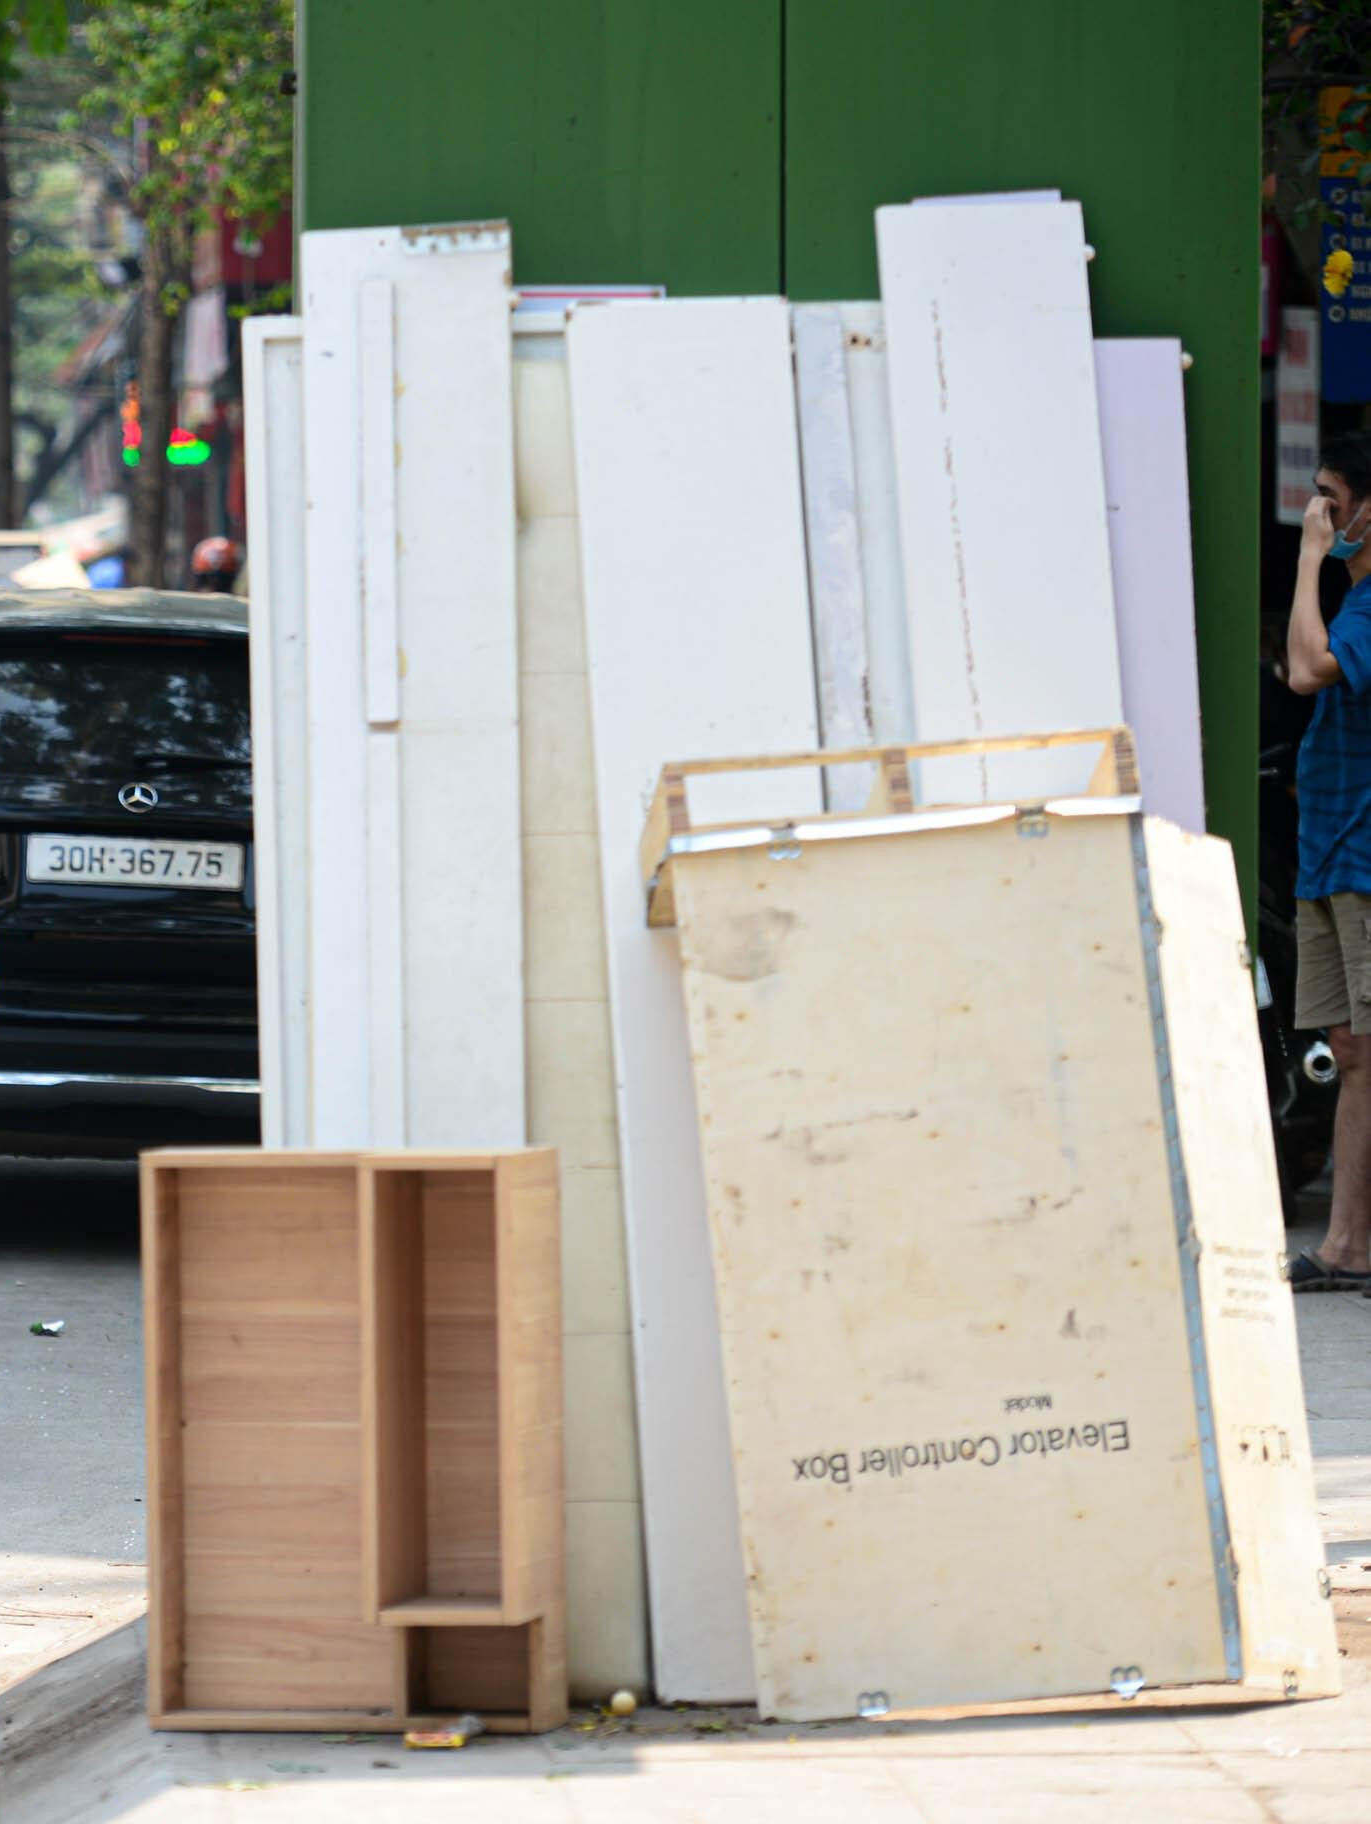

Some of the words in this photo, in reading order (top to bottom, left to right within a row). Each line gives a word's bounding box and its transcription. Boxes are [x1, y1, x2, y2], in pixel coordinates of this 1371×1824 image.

[856, 1435, 1002, 1477] Controller
[1008, 1419, 1131, 1458] Elevator
[791, 1453, 851, 1484] Box
